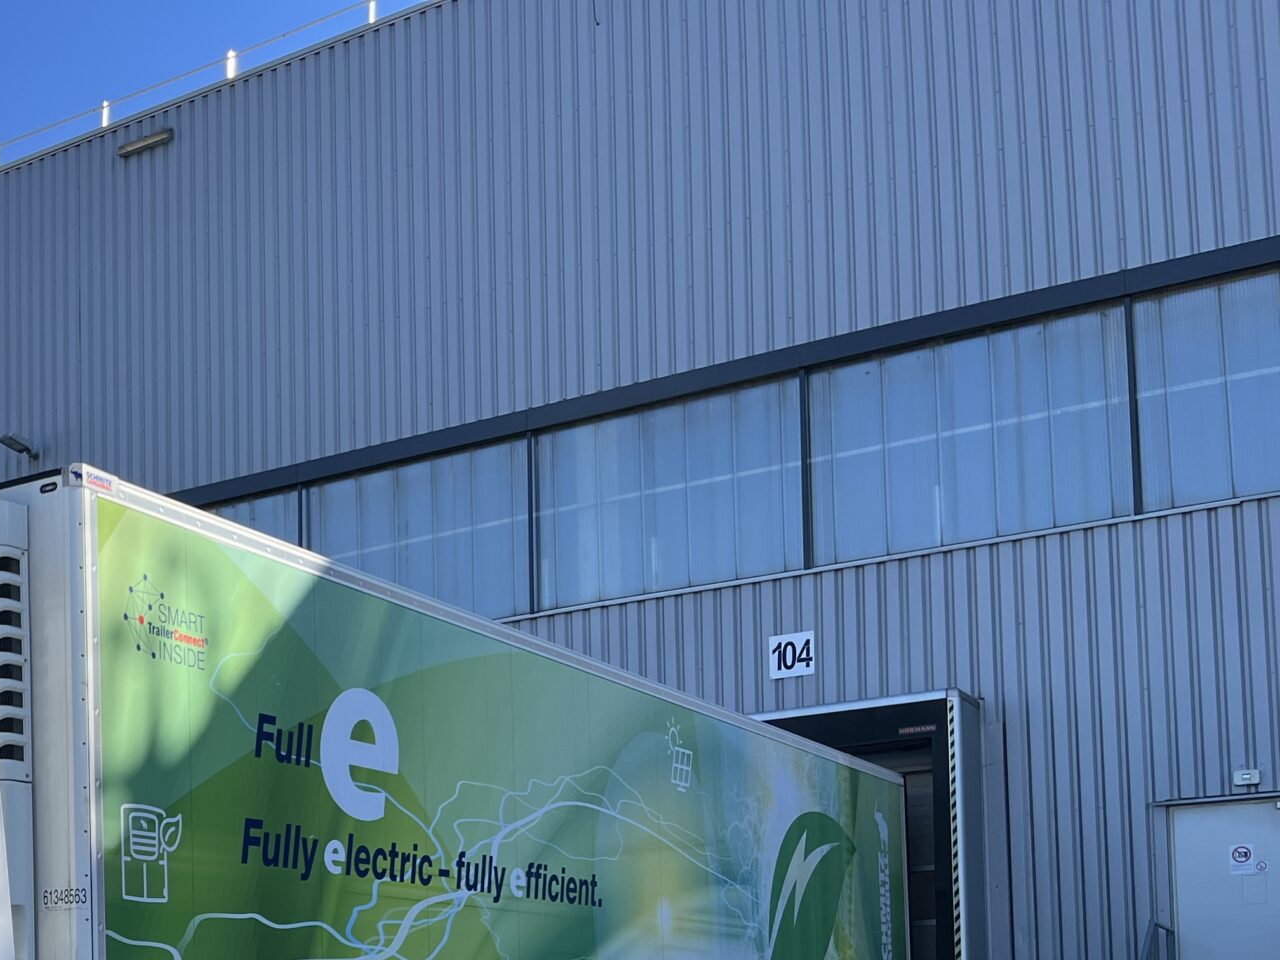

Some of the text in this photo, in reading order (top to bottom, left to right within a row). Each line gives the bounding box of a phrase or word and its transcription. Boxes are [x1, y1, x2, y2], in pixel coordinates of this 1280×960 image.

[158, 603, 206, 634] SMART
[158, 640, 206, 671] INSIDE
[772, 638, 813, 671] 104
[255, 687, 399, 822] Full e
[241, 818, 319, 881] Fully
[323, 833, 433, 887] electric
[456, 851, 506, 903] fully
[509, 861, 603, 908] efficient.
[43, 888, 88, 906] 61348563
